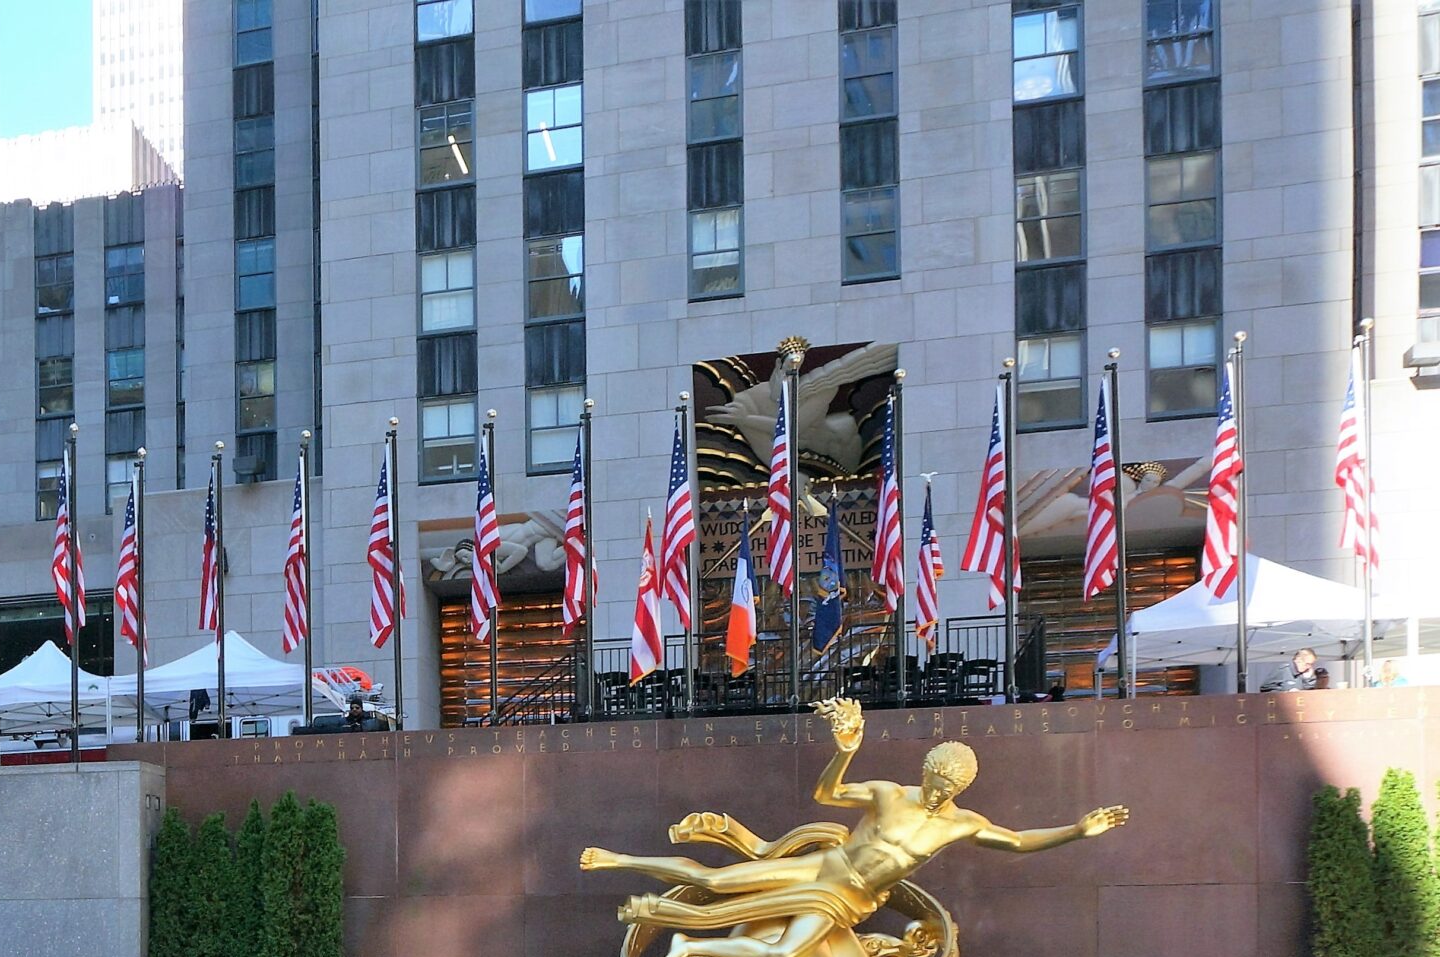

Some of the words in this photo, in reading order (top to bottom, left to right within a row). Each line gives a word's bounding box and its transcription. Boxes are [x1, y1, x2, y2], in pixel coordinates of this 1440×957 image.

[492, 726, 641, 740] TEACHER
[683, 722, 714, 733] IN
[755, 719, 813, 730] EVE
[906, 710, 969, 724] ART
[1237, 697, 1305, 710] THE
[233, 752, 302, 764] THAT
[338, 748, 411, 760] HATH
[610, 739, 642, 749] TO
[680, 734, 815, 746] MORTAL
[932, 722, 1049, 736] MEANS
[1096, 719, 1134, 729] TO
